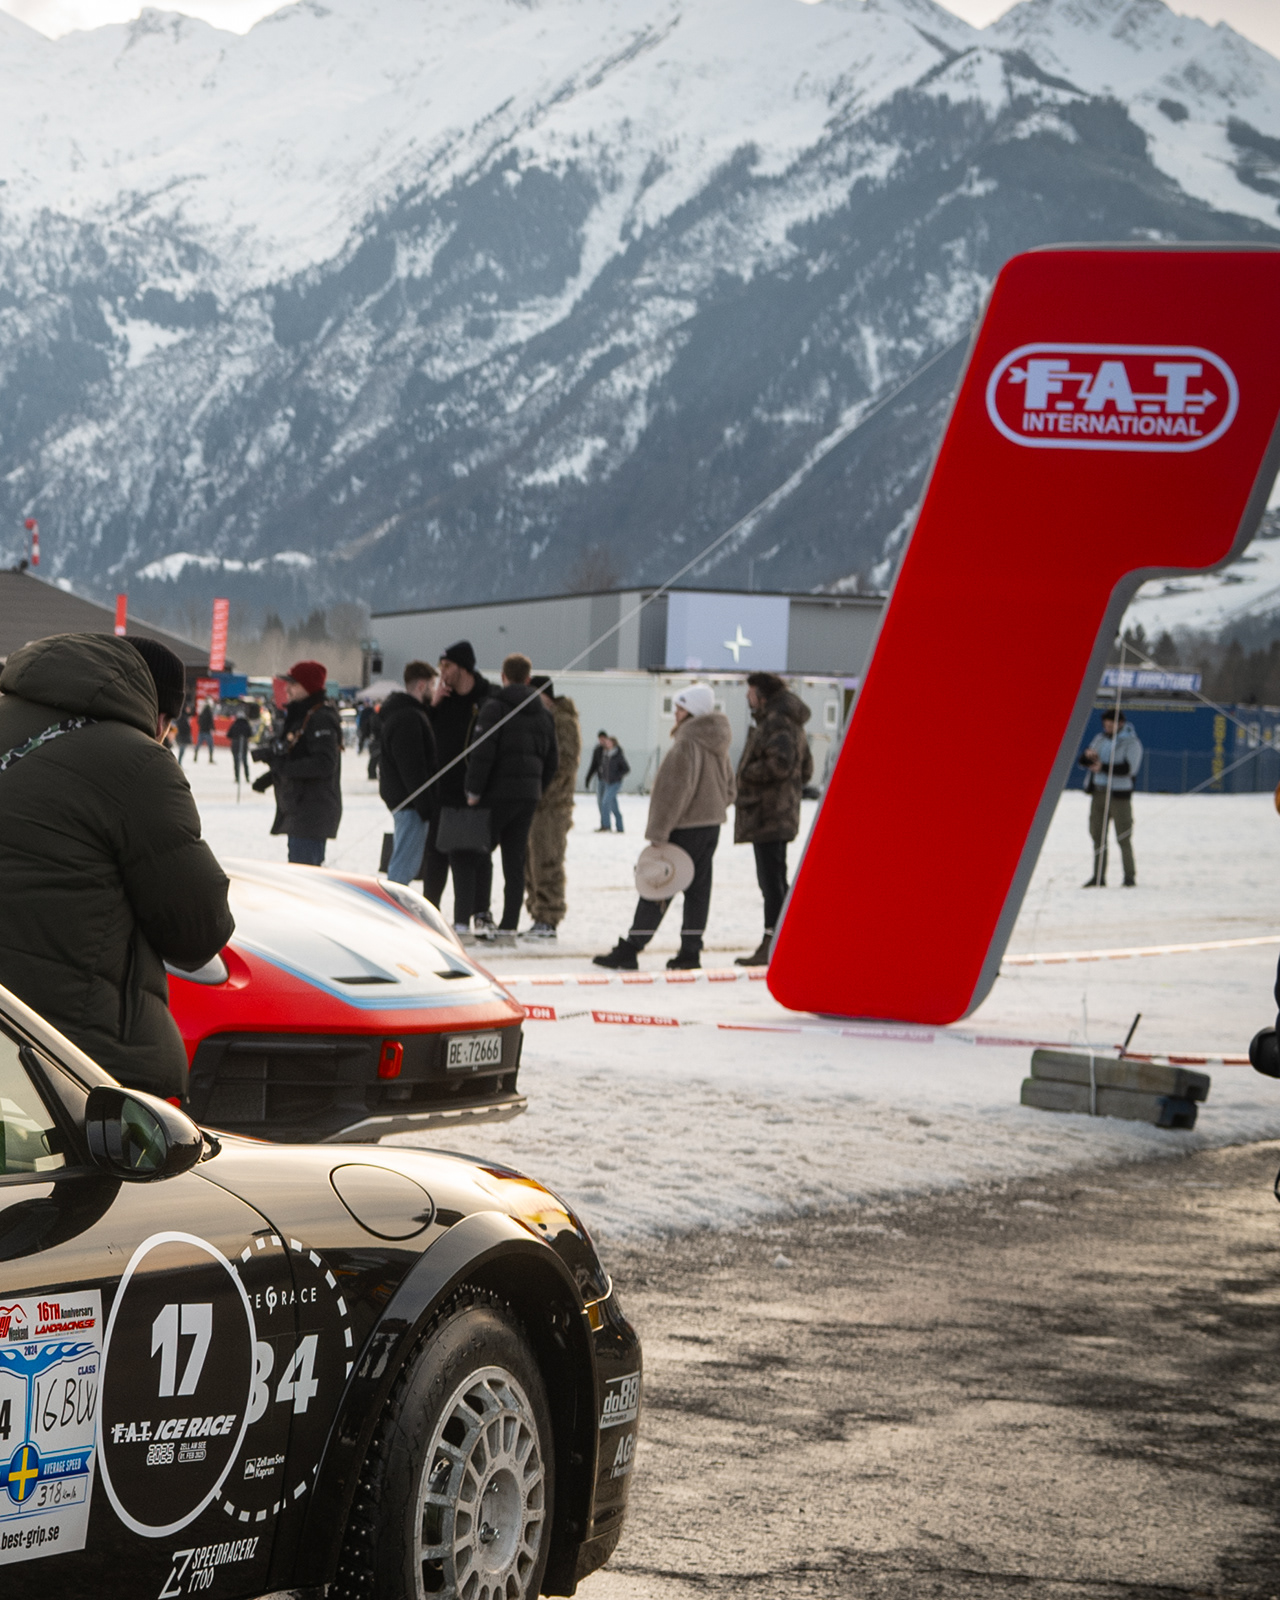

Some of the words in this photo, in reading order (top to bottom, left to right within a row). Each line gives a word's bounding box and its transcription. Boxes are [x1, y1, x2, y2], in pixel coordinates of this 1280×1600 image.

[1023, 359, 1206, 414] F.A.T.
[1022, 412, 1203, 436] INTERNATIONAL
[37, 1301, 60, 1321] 16TH
[24, 1345, 38, 1357] 2024
[151, 1303, 213, 1397] 17
[77, 1365, 96, 1375] CLASS
[153, 1418, 188, 1441] ICE
[184, 1414, 237, 1438] RACE
[43, 1461, 65, 1476] AVERAGE
[65, 1457, 82, 1471] SPEED
[255, 1467, 275, 1480] Kaprun
[191, 1536, 260, 1570] SPEEDRACERZ
[187, 1566, 215, 1593] 1700
